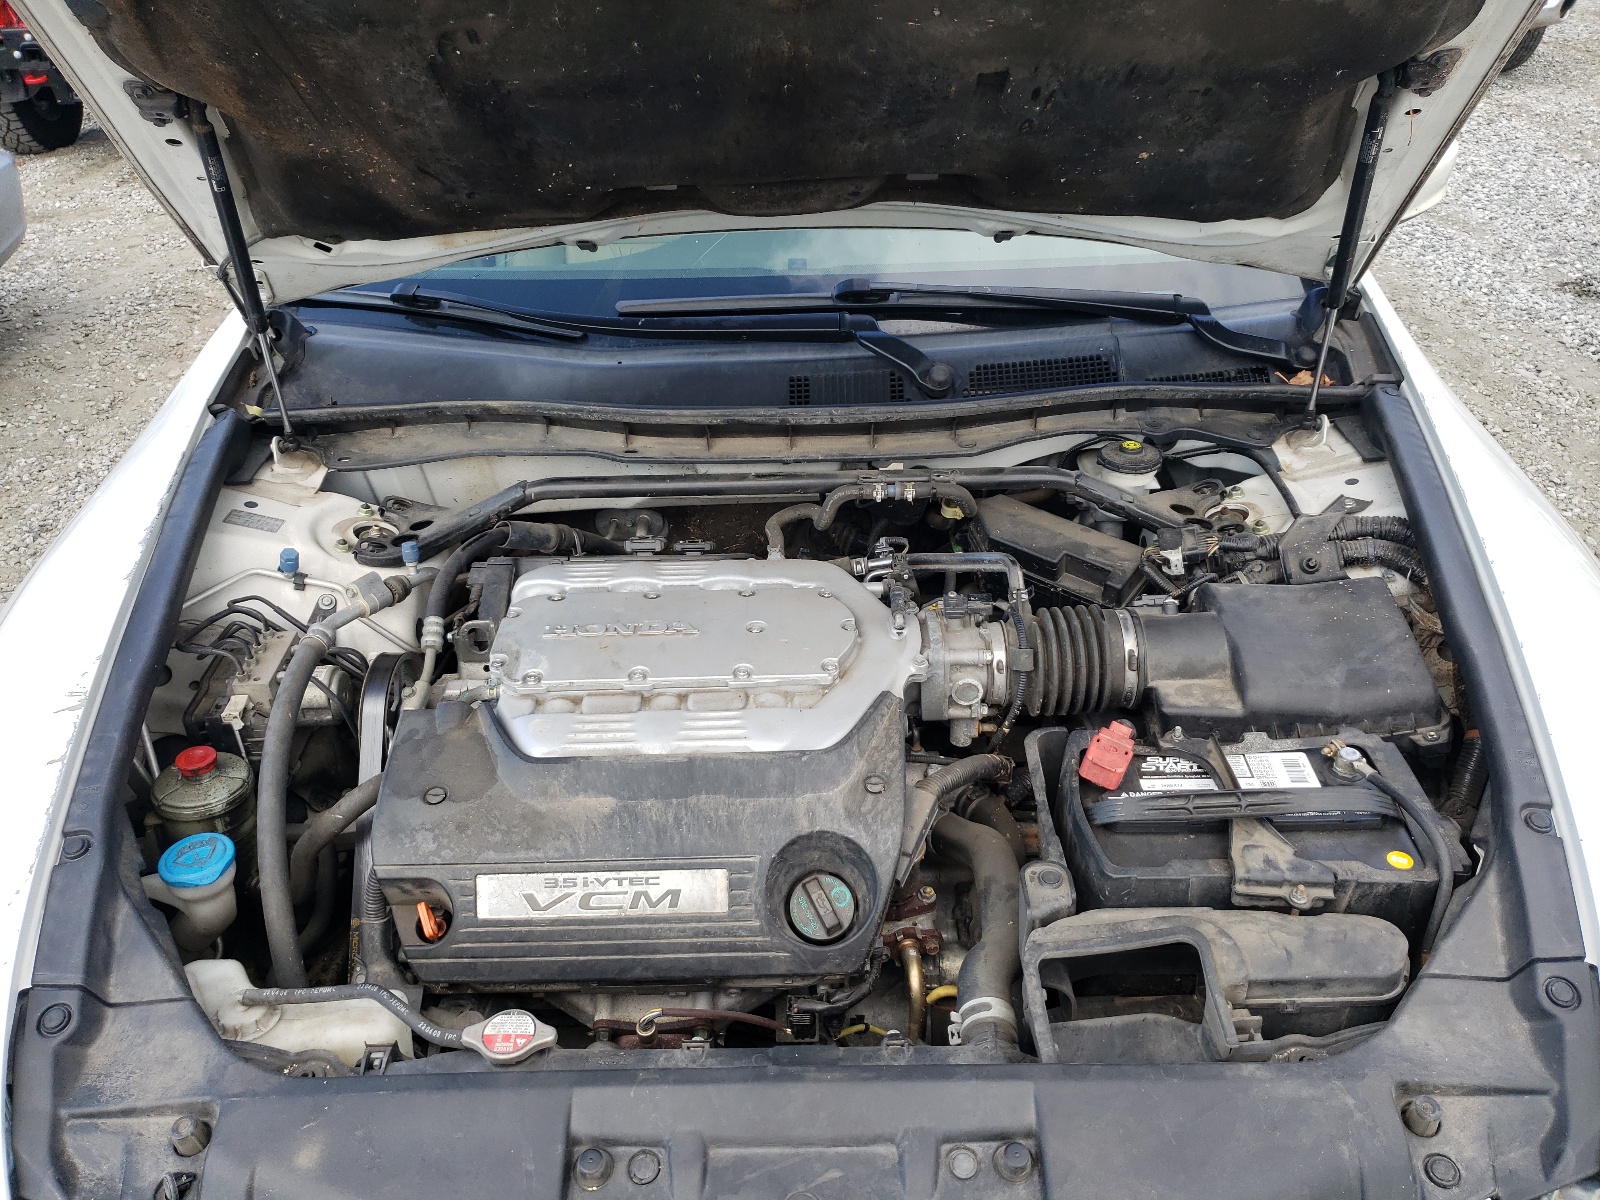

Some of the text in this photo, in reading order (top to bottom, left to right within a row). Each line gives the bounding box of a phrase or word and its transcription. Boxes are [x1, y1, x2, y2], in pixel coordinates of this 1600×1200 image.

[542, 620, 700, 640] HONDA
[1146, 756, 1193, 765] SUPE
[543, 876, 660, 889] 3.5 i-VTEC
[521, 888, 682, 912] VCM
